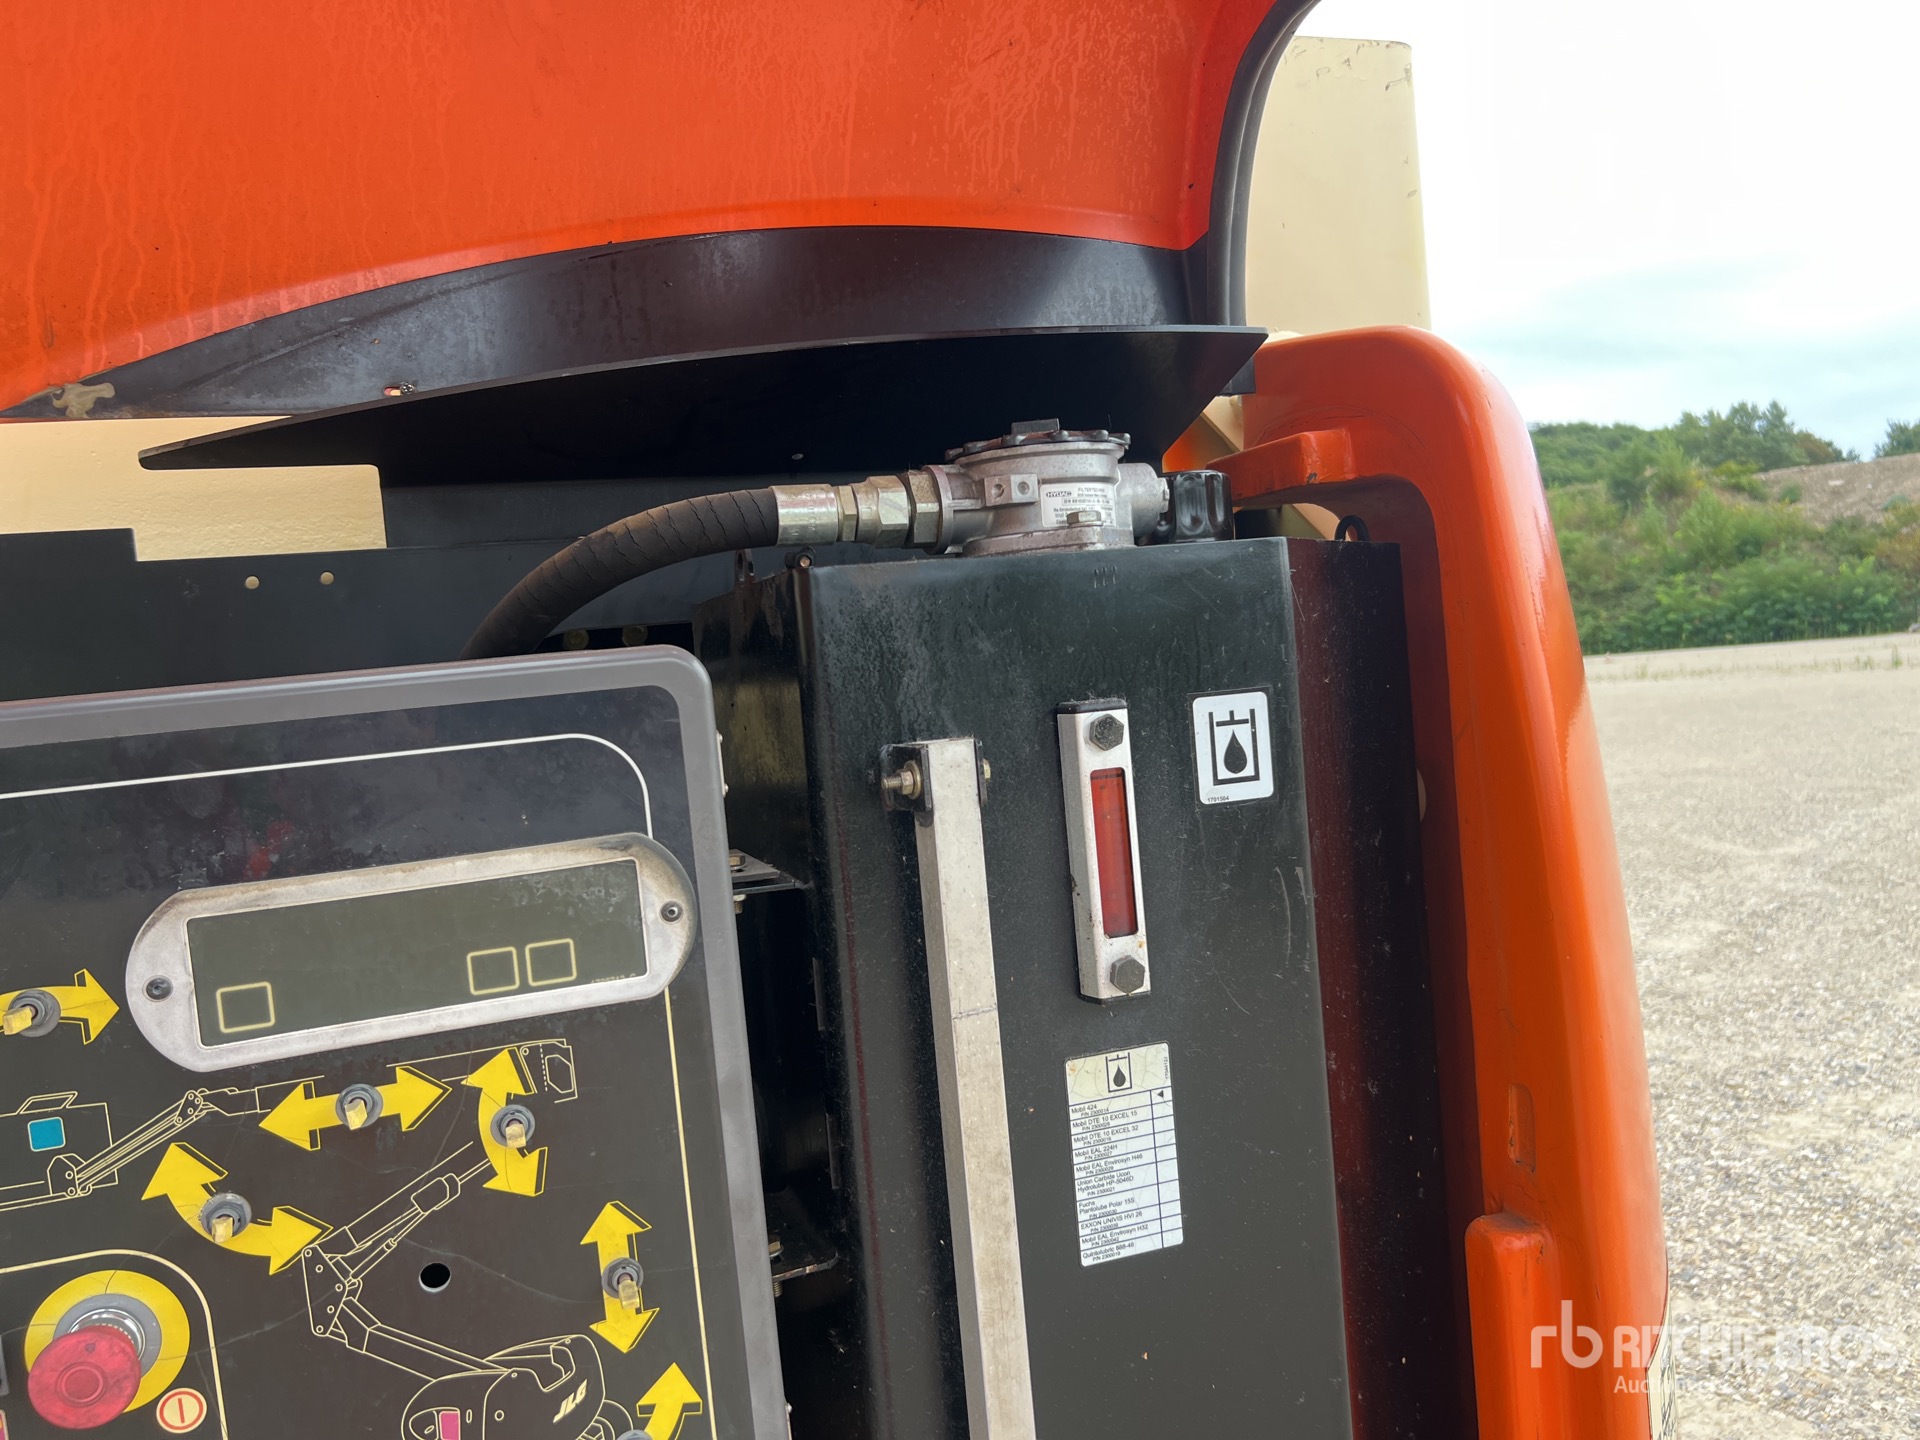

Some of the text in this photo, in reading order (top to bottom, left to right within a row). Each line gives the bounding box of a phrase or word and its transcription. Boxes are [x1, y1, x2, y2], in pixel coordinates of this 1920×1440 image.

[1072, 1120, 1087, 1128] Mobil
[1088, 1117, 1100, 1125] DTE
[1110, 1112, 1129, 1120] EXCEL
[1073, 1134, 1088, 1142] Mobil
[1111, 1126, 1130, 1135] EXCEL
[1075, 1149, 1089, 1157] Mobil
[1076, 1164, 1090, 1172] Mobil
[1104, 1156, 1131, 1167] Envirosyn
[1131, 1153, 1143, 1161] H46
[1077, 1170, 1131, 1186] Union Carbide Ucon
[1077, 1182, 1105, 1193] Hydrolube
[1079, 1200, 1095, 1208] Fuchs
[1079, 1203, 1107, 1215] Plantolube
[1108, 1200, 1122, 1208] Polar
[1081, 1220, 1102, 1229] EXXON
[1103, 1215, 1123, 1224] UNIVIS
[1082, 1236, 1096, 1244] Mobil
[1110, 1227, 1136, 1238] Envirosyn
[1083, 1246, 1114, 1259] Quintolubric
[553, 1379, 587, 1424] JLG
